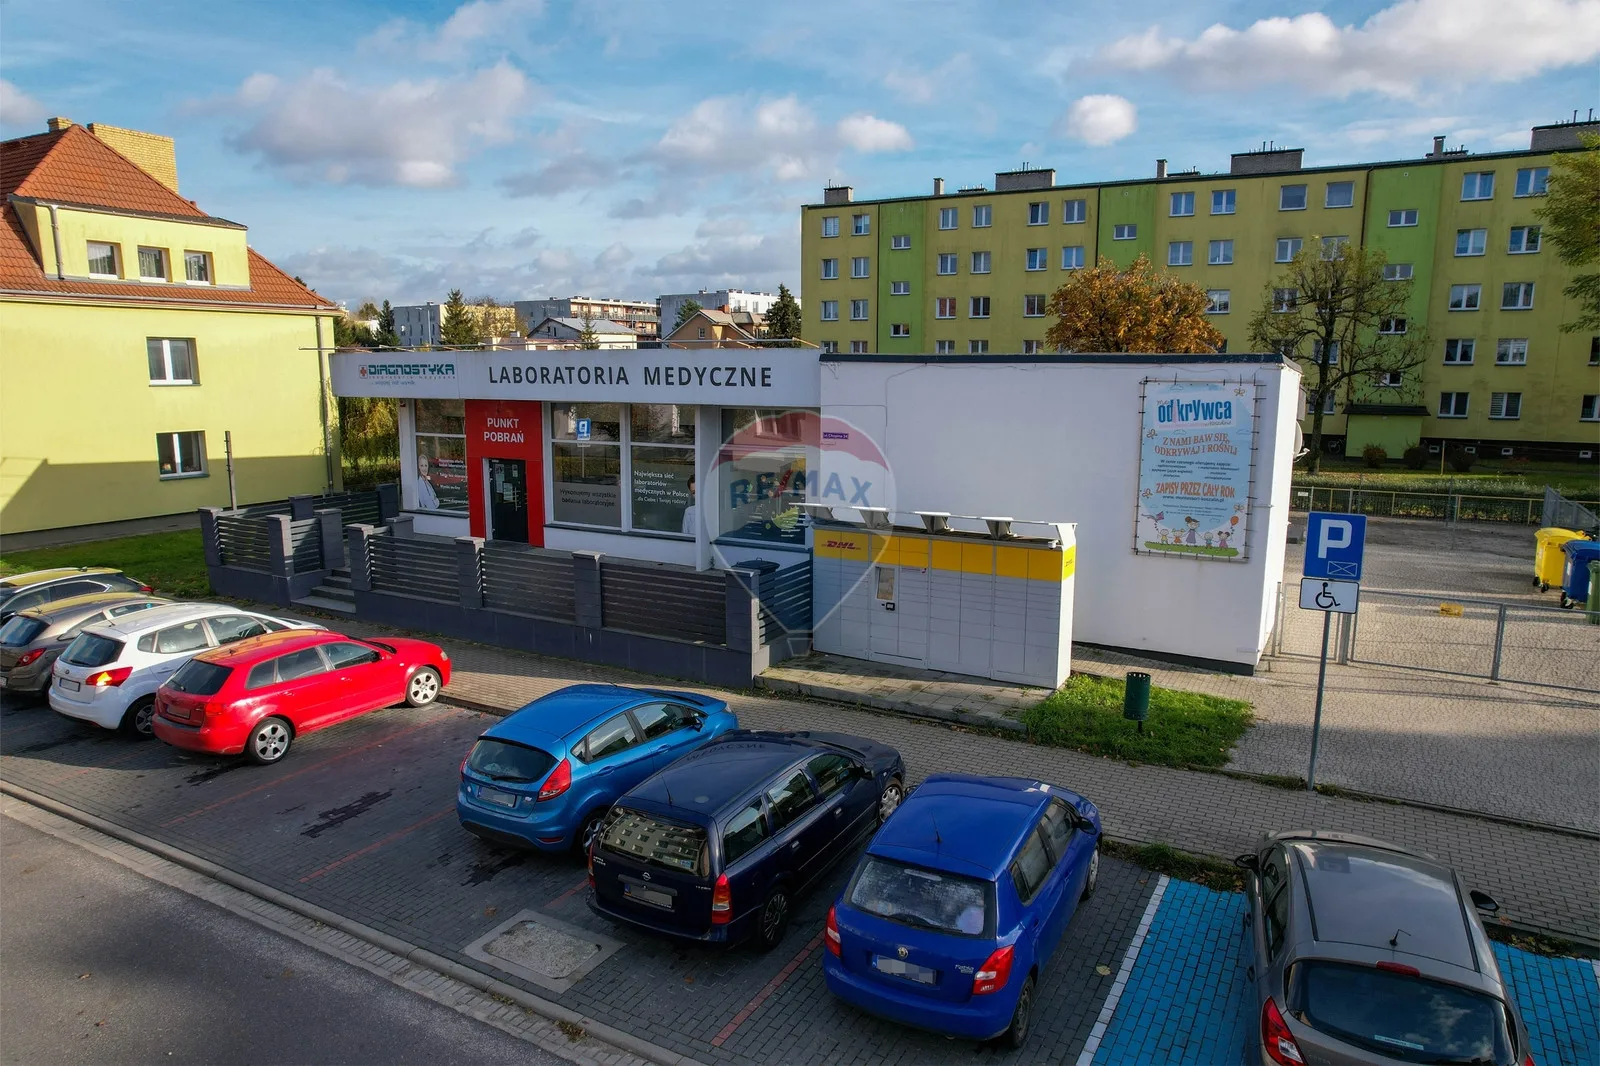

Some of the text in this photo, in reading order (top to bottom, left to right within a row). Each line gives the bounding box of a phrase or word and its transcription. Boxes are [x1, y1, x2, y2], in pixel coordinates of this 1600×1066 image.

[489, 366, 772, 387] LABORATORIA MEDYCZNE
[487, 417, 519, 429] PUNKT
[483, 430, 524, 443] POBRAŃ
[1162, 436, 1169, 446] Z
[1169, 436, 1192, 446] NAMI
[1193, 433, 1214, 444] BAW
[1154, 445, 1200, 457] ODKRYWAJ
[1207, 441, 1238, 455] ROŚNIJ
[634, 470, 663, 478] Największa
[634, 488, 665, 496] medycznych
[1156, 482, 1235, 498] ZAPISY PRZEZ CAŁY ROK
[826, 540, 856, 550] DHL
[1318, 518, 1353, 559] P
